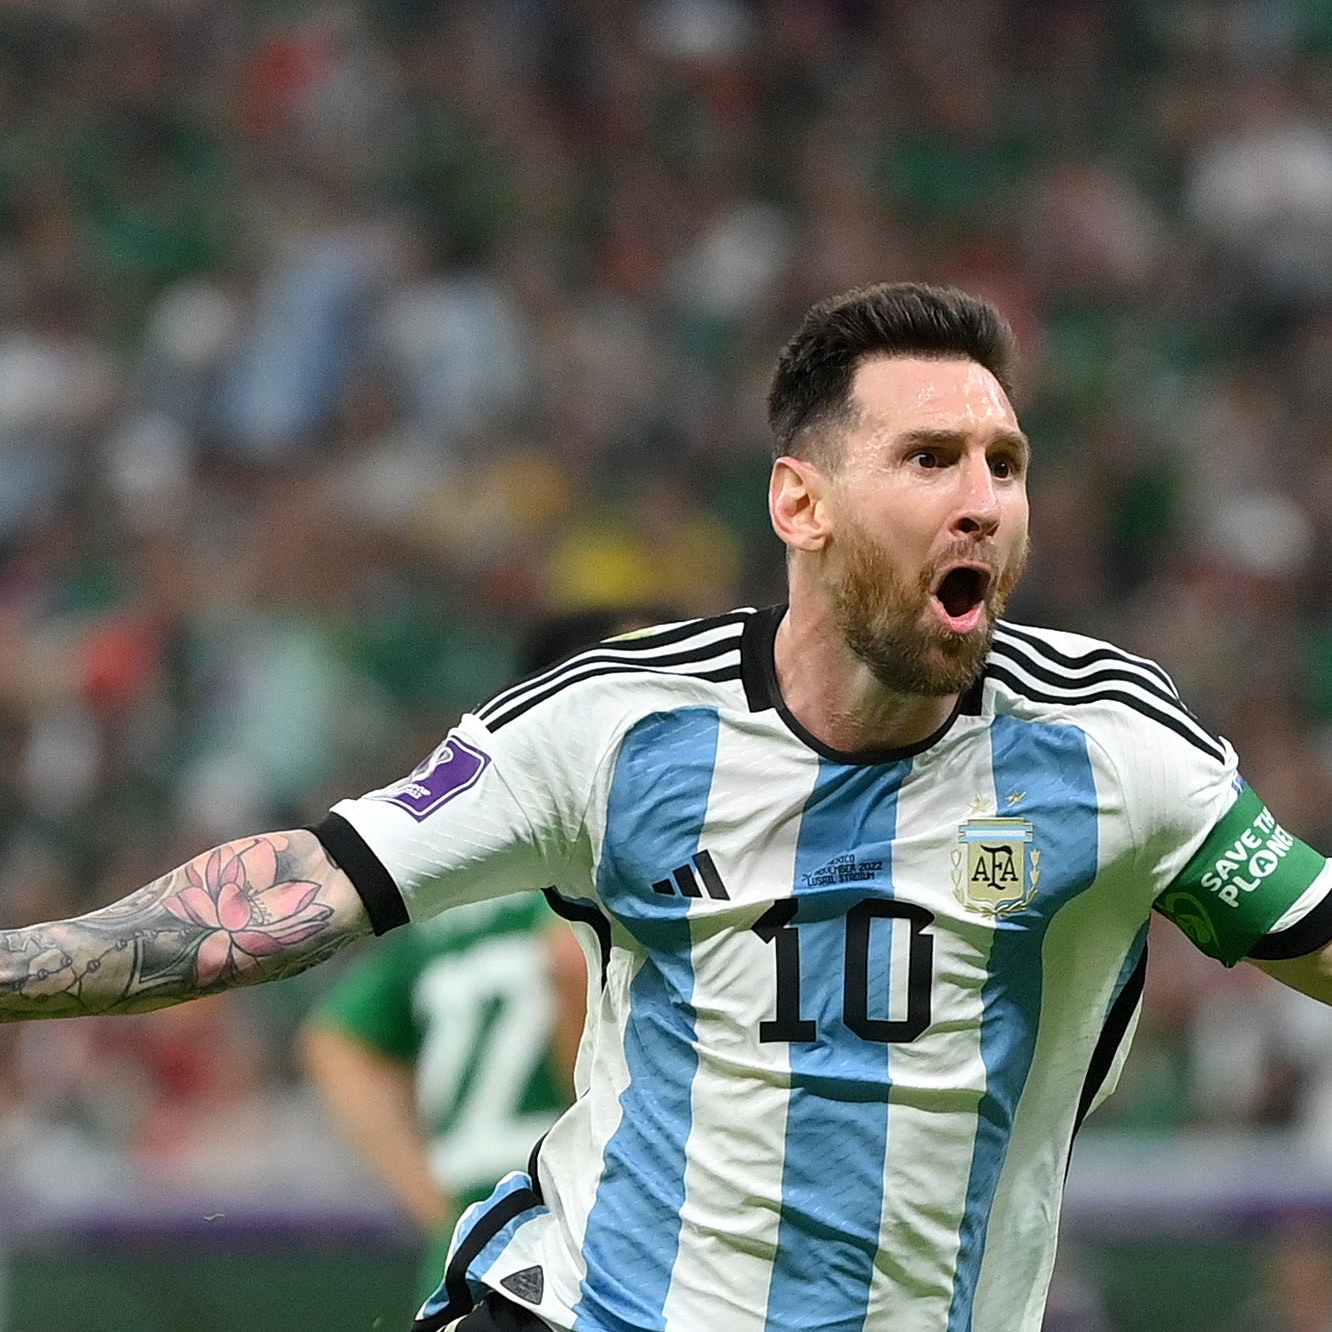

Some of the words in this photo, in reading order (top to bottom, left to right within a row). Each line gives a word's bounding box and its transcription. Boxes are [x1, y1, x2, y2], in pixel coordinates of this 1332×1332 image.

[858, 861, 883, 872] 2022
[971, 844, 1019, 890] AFA
[1201, 827, 1262, 891] SAVE
[1253, 805, 1276, 834] TH
[839, 871, 875, 884] STADIUM
[751, 897, 935, 1043] 10
